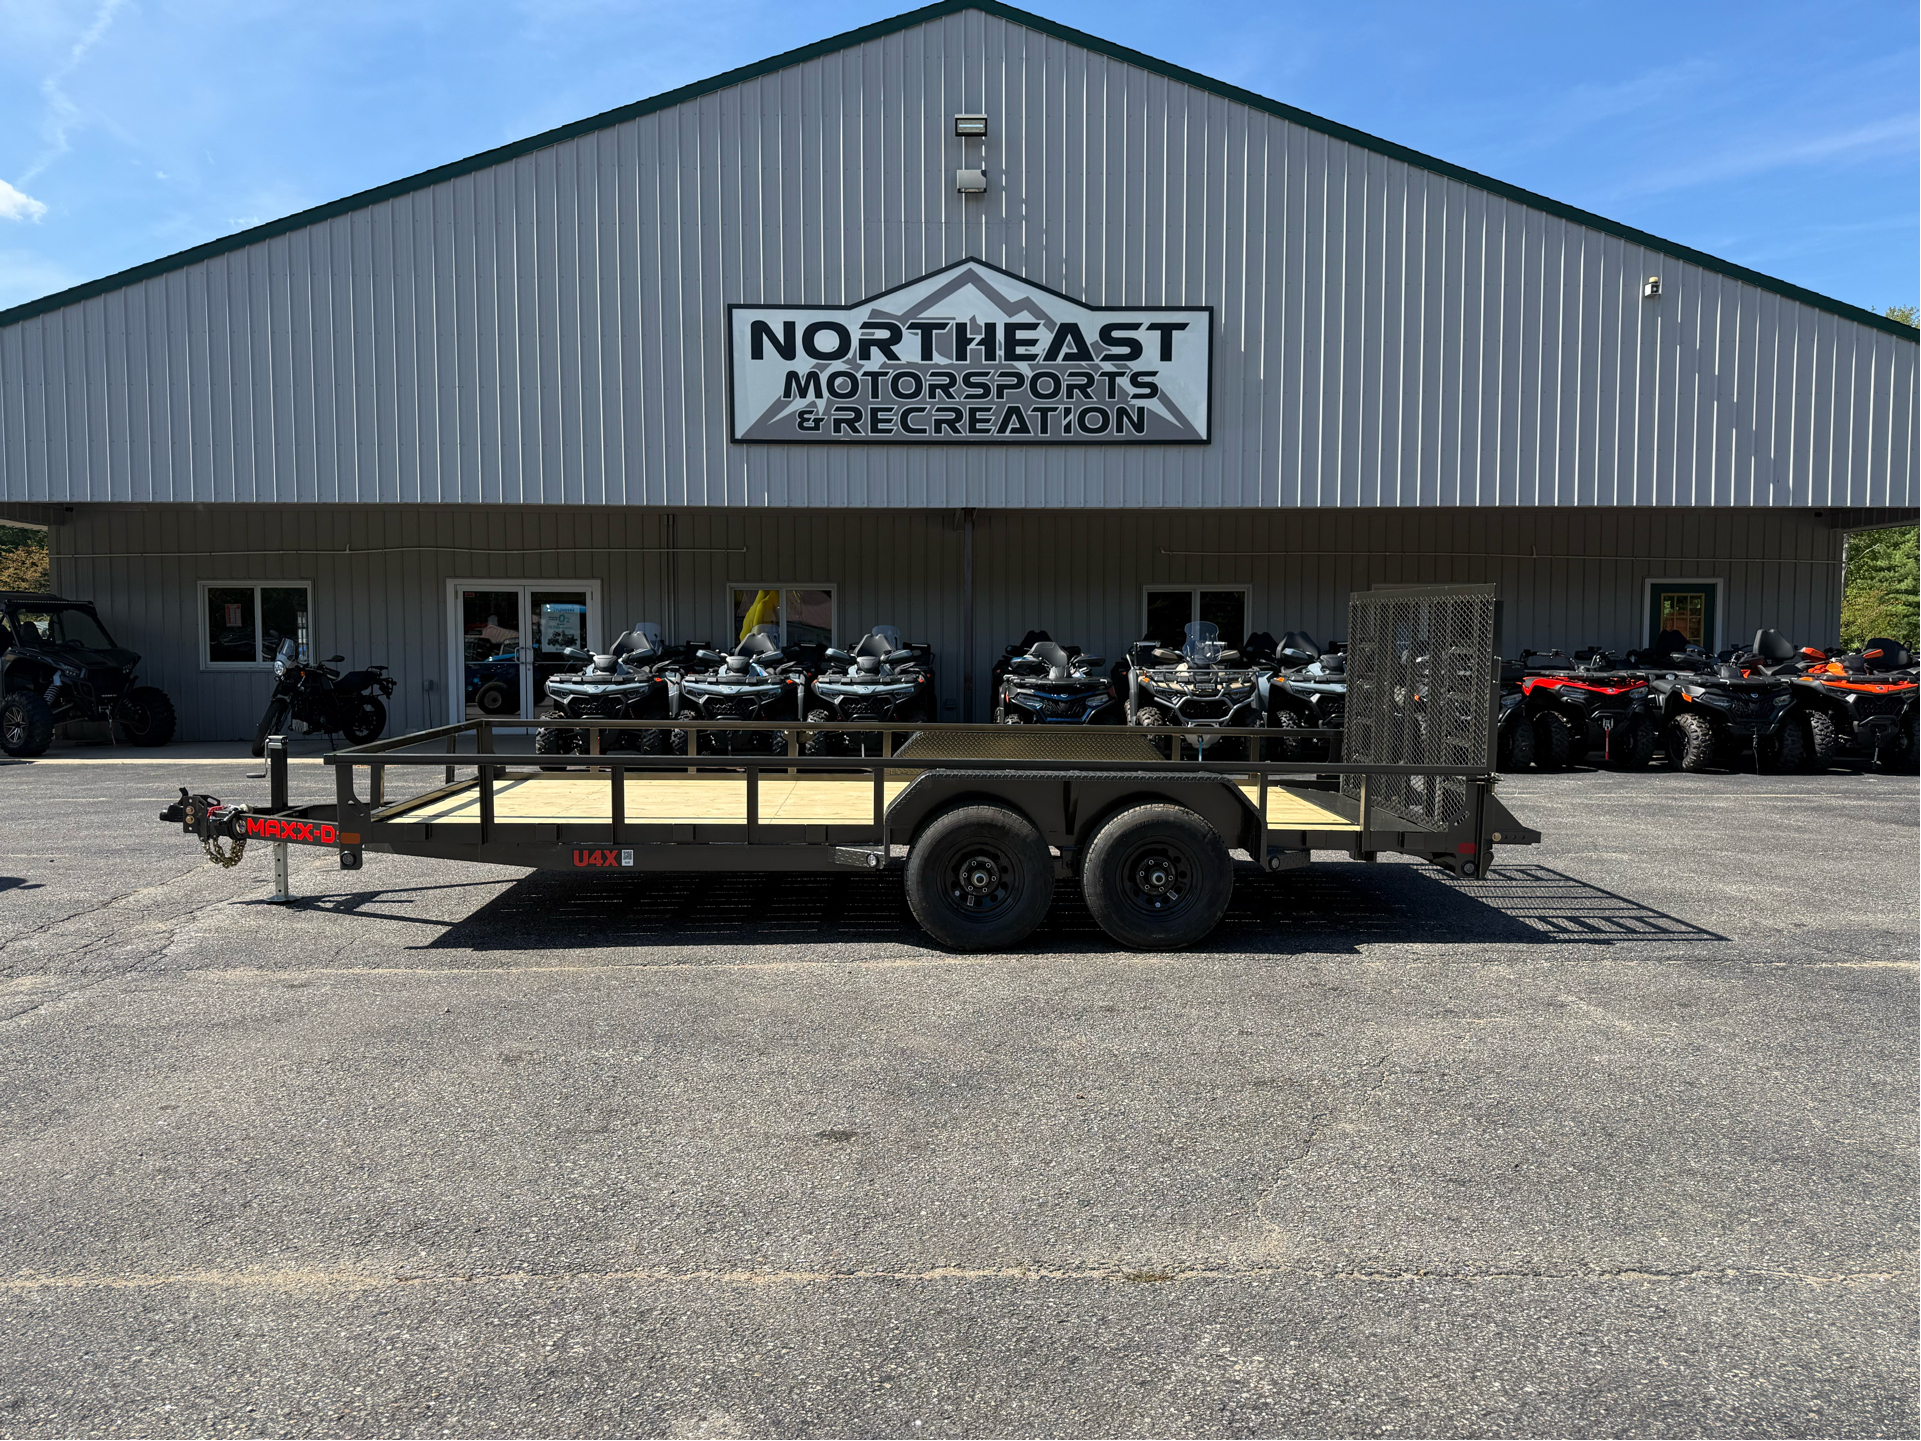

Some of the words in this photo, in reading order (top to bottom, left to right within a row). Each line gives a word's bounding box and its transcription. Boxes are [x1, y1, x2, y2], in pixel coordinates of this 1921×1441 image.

[751, 321, 1190, 361] NORTHEAST
[783, 371, 1158, 399] MOTORSPORTS
[247, 818, 336, 844] MAXX-D
[573, 850, 619, 867] U4X
